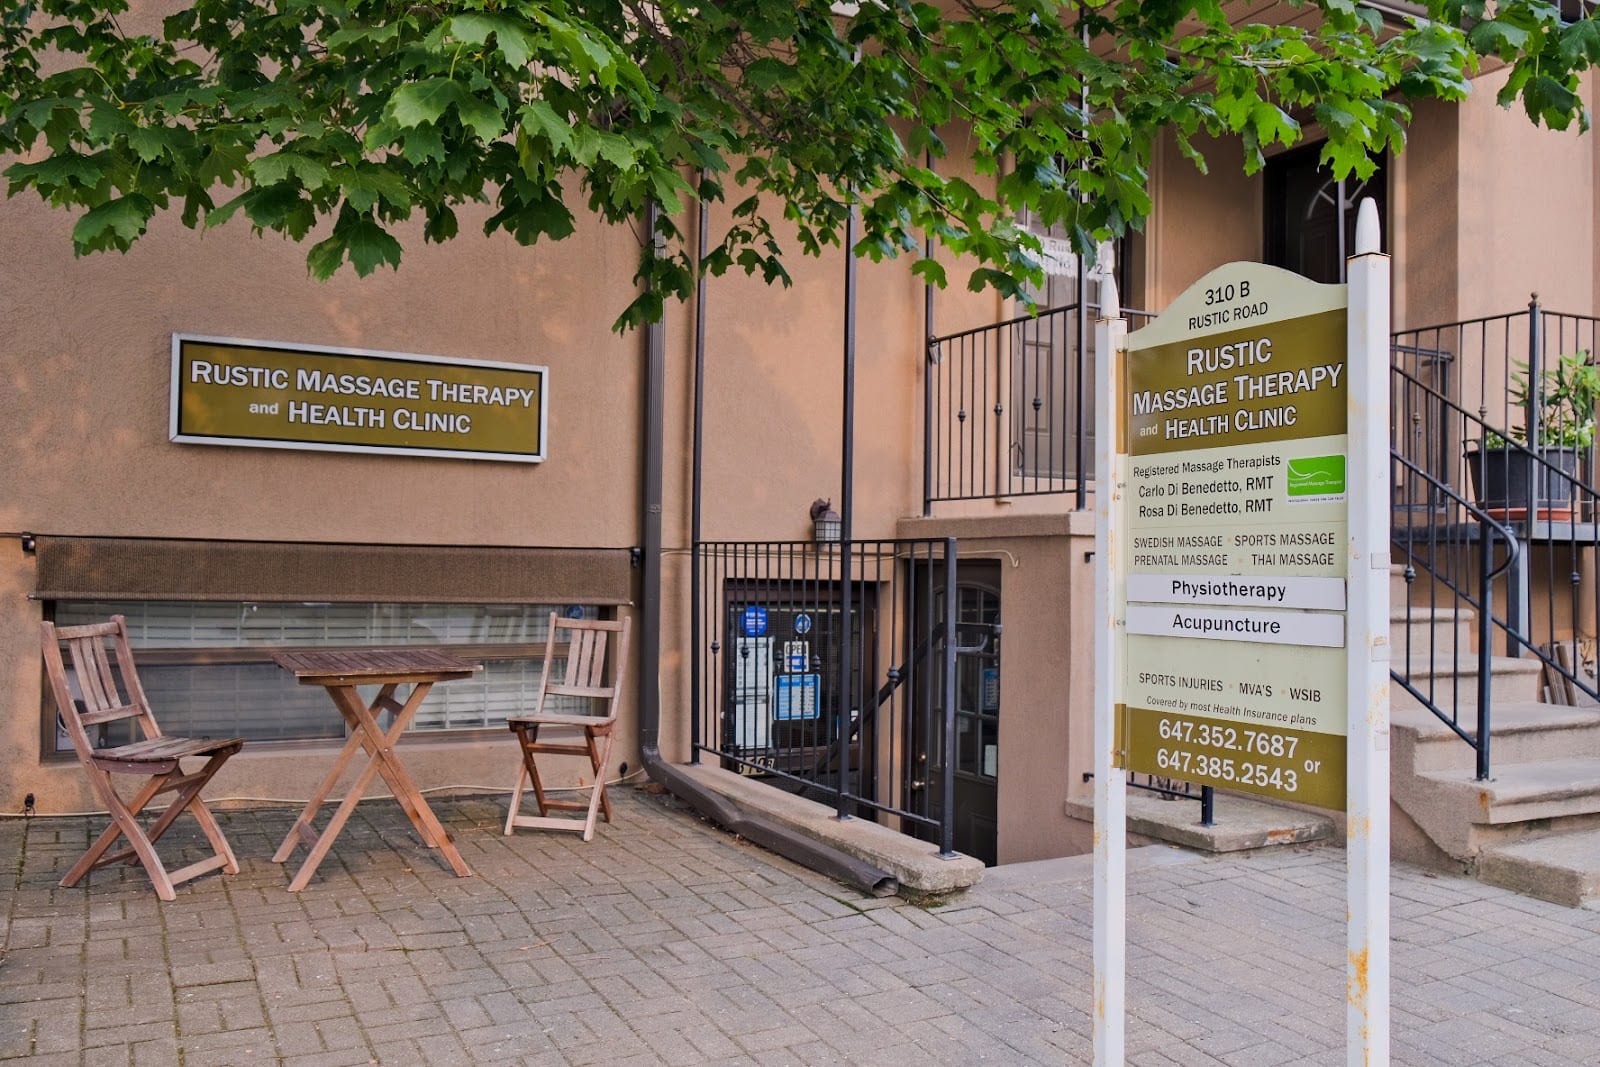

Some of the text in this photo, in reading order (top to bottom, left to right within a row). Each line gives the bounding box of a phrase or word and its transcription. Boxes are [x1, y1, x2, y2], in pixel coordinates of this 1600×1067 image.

[1205, 280, 1250, 306] 310 B
[1188, 301, 1268, 331] RUSTIC ROAD
[1187, 338, 1272, 376] RUSTIC
[191, 359, 535, 409] RUSTIC MASSAGE THERAPY
[1133, 363, 1343, 416] MASSAGE THERAPY
[248, 400, 472, 434] and HEALTH CLINIC
[1139, 406, 1297, 440] and HEALTH CLINIC
[1133, 454, 1281, 479] Registered Massage Therapists
[1138, 483, 1165, 498] Carlo
[1167, 483, 1179, 496] Di
[1181, 479, 1243, 496] Benedetto,
[1246, 476, 1274, 492] RMT
[1139, 498, 1273, 518] Rosa Di Benedetto, RMT
[1134, 535, 1223, 549] SWEDISH MASSAGE
[1234, 532, 1335, 547] SPORTS MASSAGE
[1134, 554, 1228, 566] PRENATAL MASSAGE
[1251, 553, 1334, 566] THAI MASSAGE
[1171, 580, 1286, 601] Physiotherapy
[1172, 613, 1281, 634] Acupuncture
[1138, 672, 1223, 692] SPORTS INJURIES
[1239, 682, 1273, 697] MVA'S
[1289, 687, 1321, 703] WSIB
[1146, 695, 1317, 726] Covered by most Health Insurance plans
[1158, 718, 1299, 759] 647.352.7687
[1156, 748, 1298, 792] 647.385.2543
[1304, 759, 1320, 774] or
